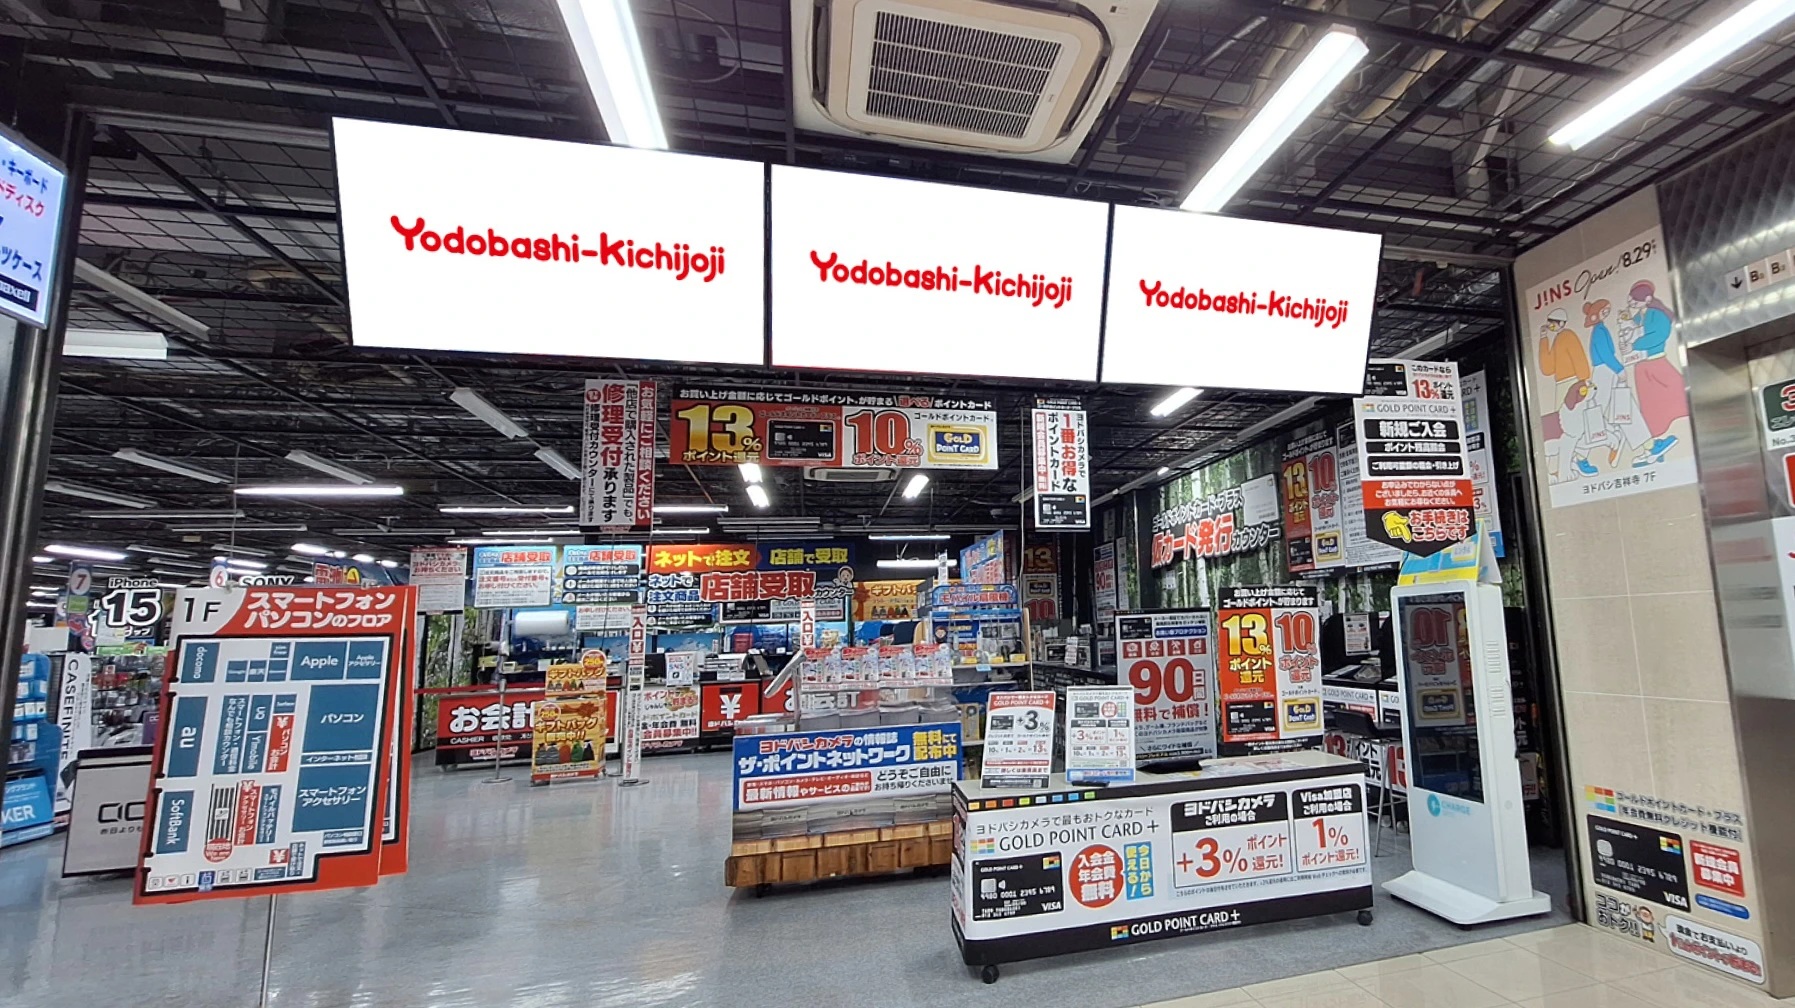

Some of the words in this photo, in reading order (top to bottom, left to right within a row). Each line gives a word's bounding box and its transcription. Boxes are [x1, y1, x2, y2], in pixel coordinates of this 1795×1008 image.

[391, 216, 725, 282] Yodobashi-Kichijoji
[1622, 242, 1652, 268] 8.29
[811, 251, 1072, 308] Yodobashi-Kichijoji
[1140, 280, 1347, 328] Yodobashi-Kichijoji
[1411, 364, 1452, 374] このカードなら
[1377, 404, 1400, 413] GOLD
[1402, 404, 1427, 413] POINT
[1429, 405, 1449, 413] CARD
[1379, 421, 1447, 438] 新規ご入会
[637, 387, 654, 519] お気軽にご相談ください
[683, 450, 760, 462] ポイント還元
[1048, 412, 1060, 492] ポイントカード
[1061, 413, 1077, 492] 1番お得な
[1583, 475, 1640, 494] ヨドバシ吉祥寺
[1643, 471, 1657, 481] 7F
[1409, 509, 1469, 526] お手続きは
[1232, 523, 1280, 551] カウンター
[1412, 525, 1468, 541] こちらです
[502, 551, 551, 563] 店舗受取
[589, 550, 637, 561] 店舗受取
[654, 549, 750, 568] ネットで注文
[770, 548, 848, 565] 店舗で受取
[76, 574, 88, 591] 7
[109, 578, 158, 588] iPhone
[216, 571, 224, 586] 6
[240, 576, 294, 585] SONY
[648, 574, 694, 587] ネットで
[700, 571, 816, 601] 店舗受取
[813, 587, 854, 598] カウンター
[248, 591, 395, 610] スマートフォン
[648, 591, 699, 603] 注文商品
[101, 588, 163, 627] 15
[184, 597, 222, 622] 1F
[245, 611, 392, 628] パソコンのフロア
[193, 646, 208, 679] docomo
[300, 655, 339, 668] Apple
[1229, 657, 1272, 671] ポイント
[1279, 656, 1319, 671] ポイント
[548, 666, 605, 679] ギフトバッグ
[1128, 657, 1194, 705] 90
[1240, 670, 1264, 684] 還元
[61, 658, 79, 761] CASEFINITE
[719, 694, 742, 719] ¥
[320, 713, 364, 724] パソコン
[535, 717, 599, 732] ギフトバッグ
[181, 725, 196, 748] au
[451, 736, 485, 744] CASHIER
[760, 731, 898, 753] ヨドバシカメラの情報誌
[912, 730, 956, 745] 無料にて
[738, 745, 910, 774] ザ・ポイントネットワーク
[913, 745, 957, 761] 配布中
[877, 765, 951, 780] どうぞご自由に
[298, 786, 366, 798] スマートフォン
[874, 777, 953, 792] お持ち帰りくださいませ
[302, 796, 361, 807] アクセサリー
[1300, 787, 1352, 802] Visa加盟店
[1184, 794, 1276, 817] ヨドバシカメラ
[1303, 801, 1352, 815] ご利用の場合
[1617, 792, 1743, 826] ゴールドポイントカード・プラス
[166, 799, 186, 845] SoftBank
[976, 807, 1154, 835] ヨドバシカメラで最もおトクなカード
[1205, 811, 1256, 826] ご利用の場合
[999, 834, 1045, 852] GOLD
[1049, 827, 1097, 845] POINT
[1102, 822, 1143, 838] CARD
[1312, 818, 1349, 848] 1%
[1247, 834, 1287, 850] ポイント
[1078, 851, 1115, 868] 入会金
[1176, 837, 1248, 878] +3%
[1252, 854, 1284, 870] 還元!
[1302, 849, 1359, 866] ポイント還元!
[1078, 866, 1116, 883] 年会費
[1139, 844, 1152, 896] 今日から
[1081, 883, 1115, 902] 無料
[1663, 891, 1689, 908] VISA
[1041, 901, 1062, 911] VISA
[1130, 921, 1162, 936] GOLD
[1165, 916, 1197, 930] POINT
[1200, 911, 1229, 925] CARD
